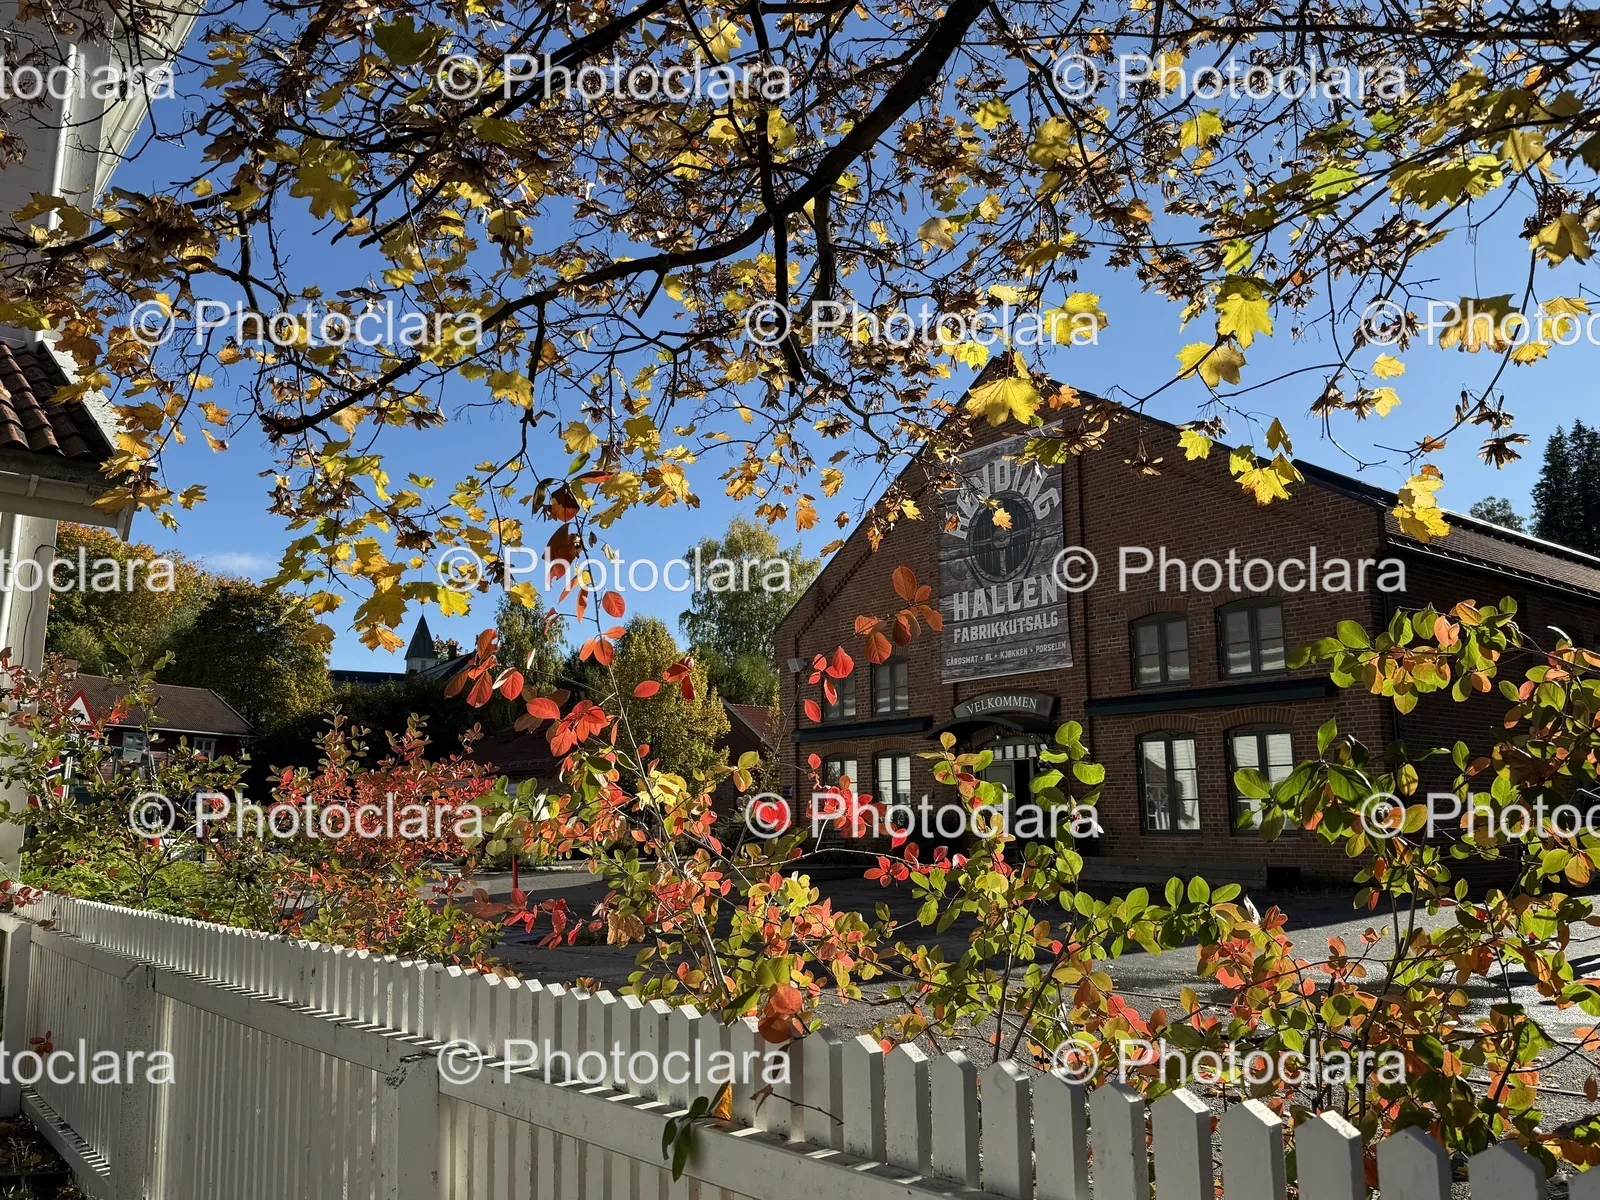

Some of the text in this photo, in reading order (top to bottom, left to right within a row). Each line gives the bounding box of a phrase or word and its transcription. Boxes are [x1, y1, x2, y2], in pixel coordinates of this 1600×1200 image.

[953, 573, 1058, 622] HALLEN
[953, 610, 1059, 644] FABRIKKUTSALG
[945, 655, 979, 667] GÅRDSMAT
[1000, 647, 1028, 659] KJØKKEN
[1035, 640, 1067, 654] PORSELEN
[966, 695, 1037, 714] VELKOMMEN
